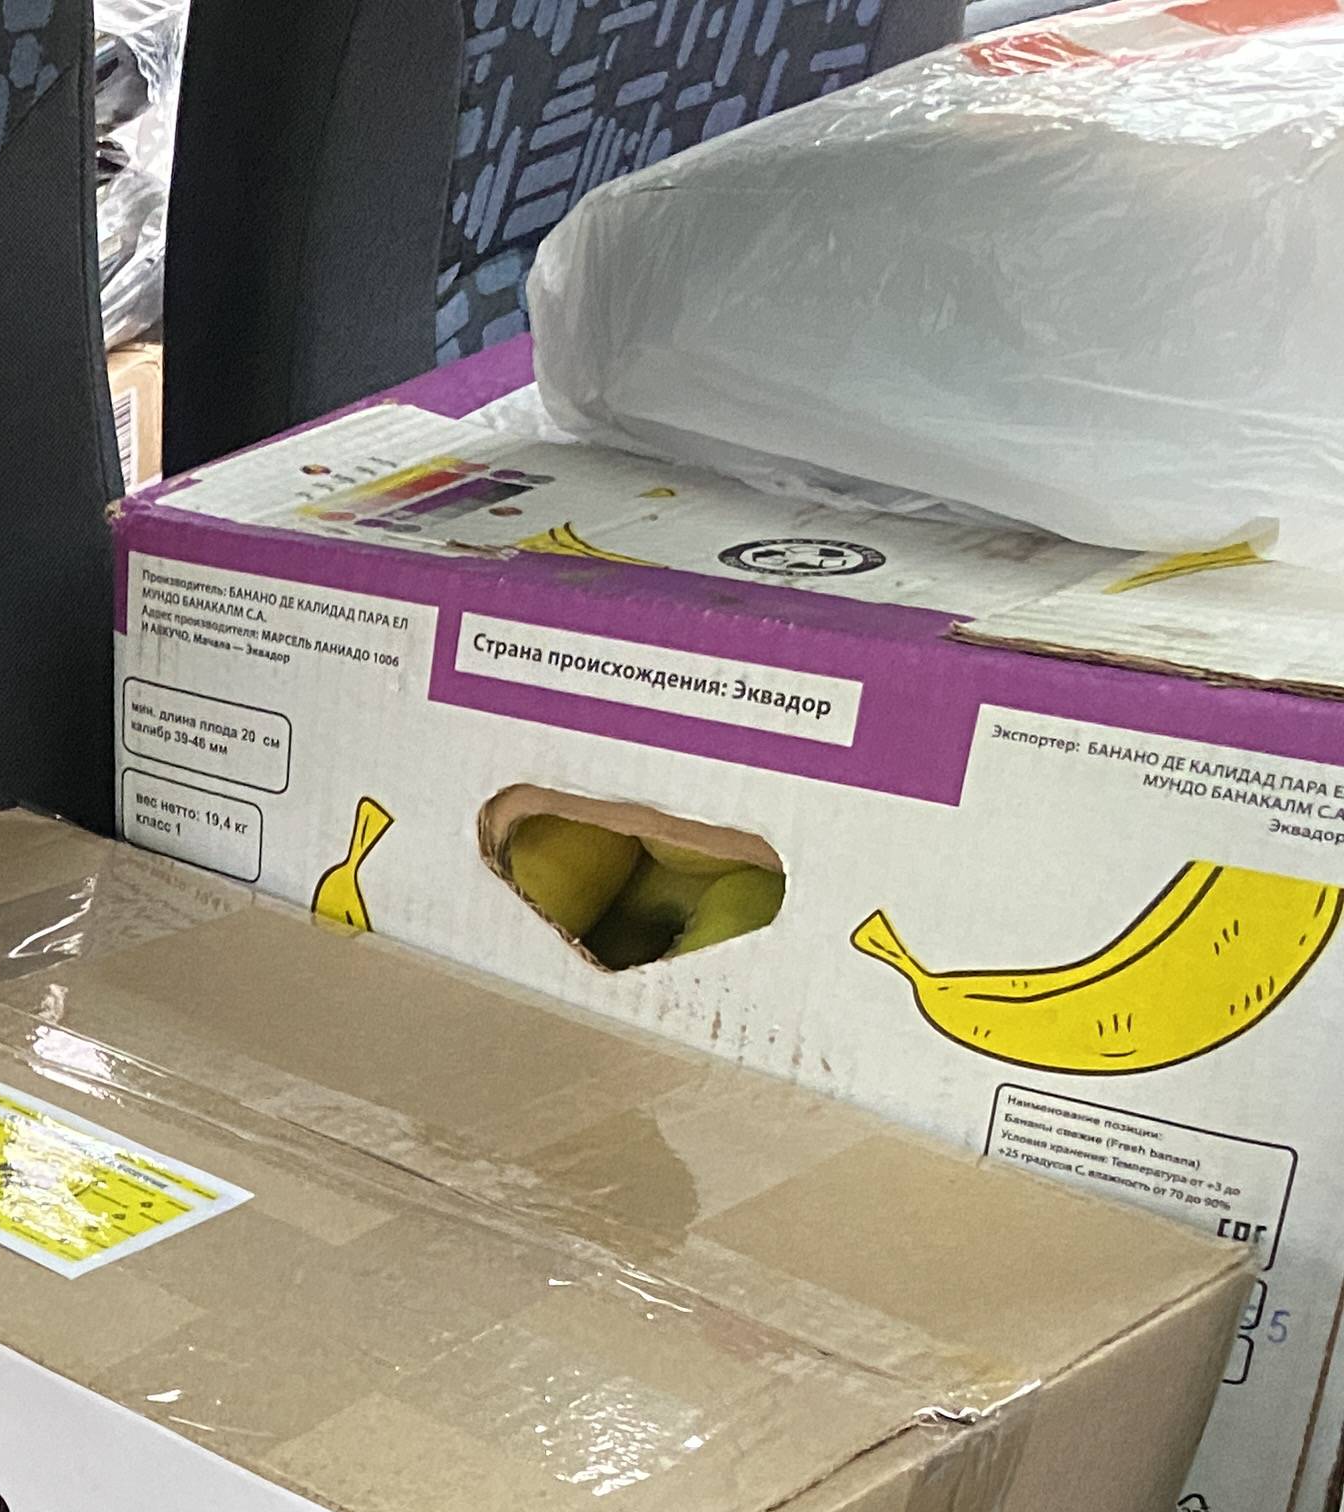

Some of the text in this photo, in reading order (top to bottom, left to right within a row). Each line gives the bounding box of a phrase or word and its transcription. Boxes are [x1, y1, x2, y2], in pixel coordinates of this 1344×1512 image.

[141, 569, 408, 630] Производитель: БАНАНО ДЕ КАЛИДАД ПАРА ЕЛ
[142, 587, 180, 605] МУНДО
[182, 597, 243, 617] БАНАКАЛМ
[142, 605, 399, 667] Адрес производителя: МАРСЕЛЬ ЛАНИАДО 1006
[246, 643, 290, 664] Эквадор
[472, 632, 832, 719] Страна происхождения: Эквадор
[131, 720, 172, 742] калибр
[209, 743, 228, 755] мм
[159, 708, 196, 728] длина
[199, 720, 238, 738] плода
[241, 728, 256, 743] 20
[263, 736, 280, 749] см
[991, 724, 1344, 799] Экспортер: БАНАНО ДЕ КАЛИДАД ПАРА Е
[136, 792, 249, 835] вес нетто: 19,4 кг
[1142, 773, 1208, 797] МУНДО
[1211, 784, 1313, 817] БАНАКАЛМ
[135, 813, 182, 836] класс 1
[1001, 1128, 1048, 1149] Условия
[1112, 1156, 1188, 1184] Температура
[1189, 1178, 1204, 1189] от
[1223, 1186, 1241, 1197] до
[1149, 1148, 1201, 1171] banana)
[1152, 1186, 1167, 1197] от
[1184, 1194, 1202, 1205] до
